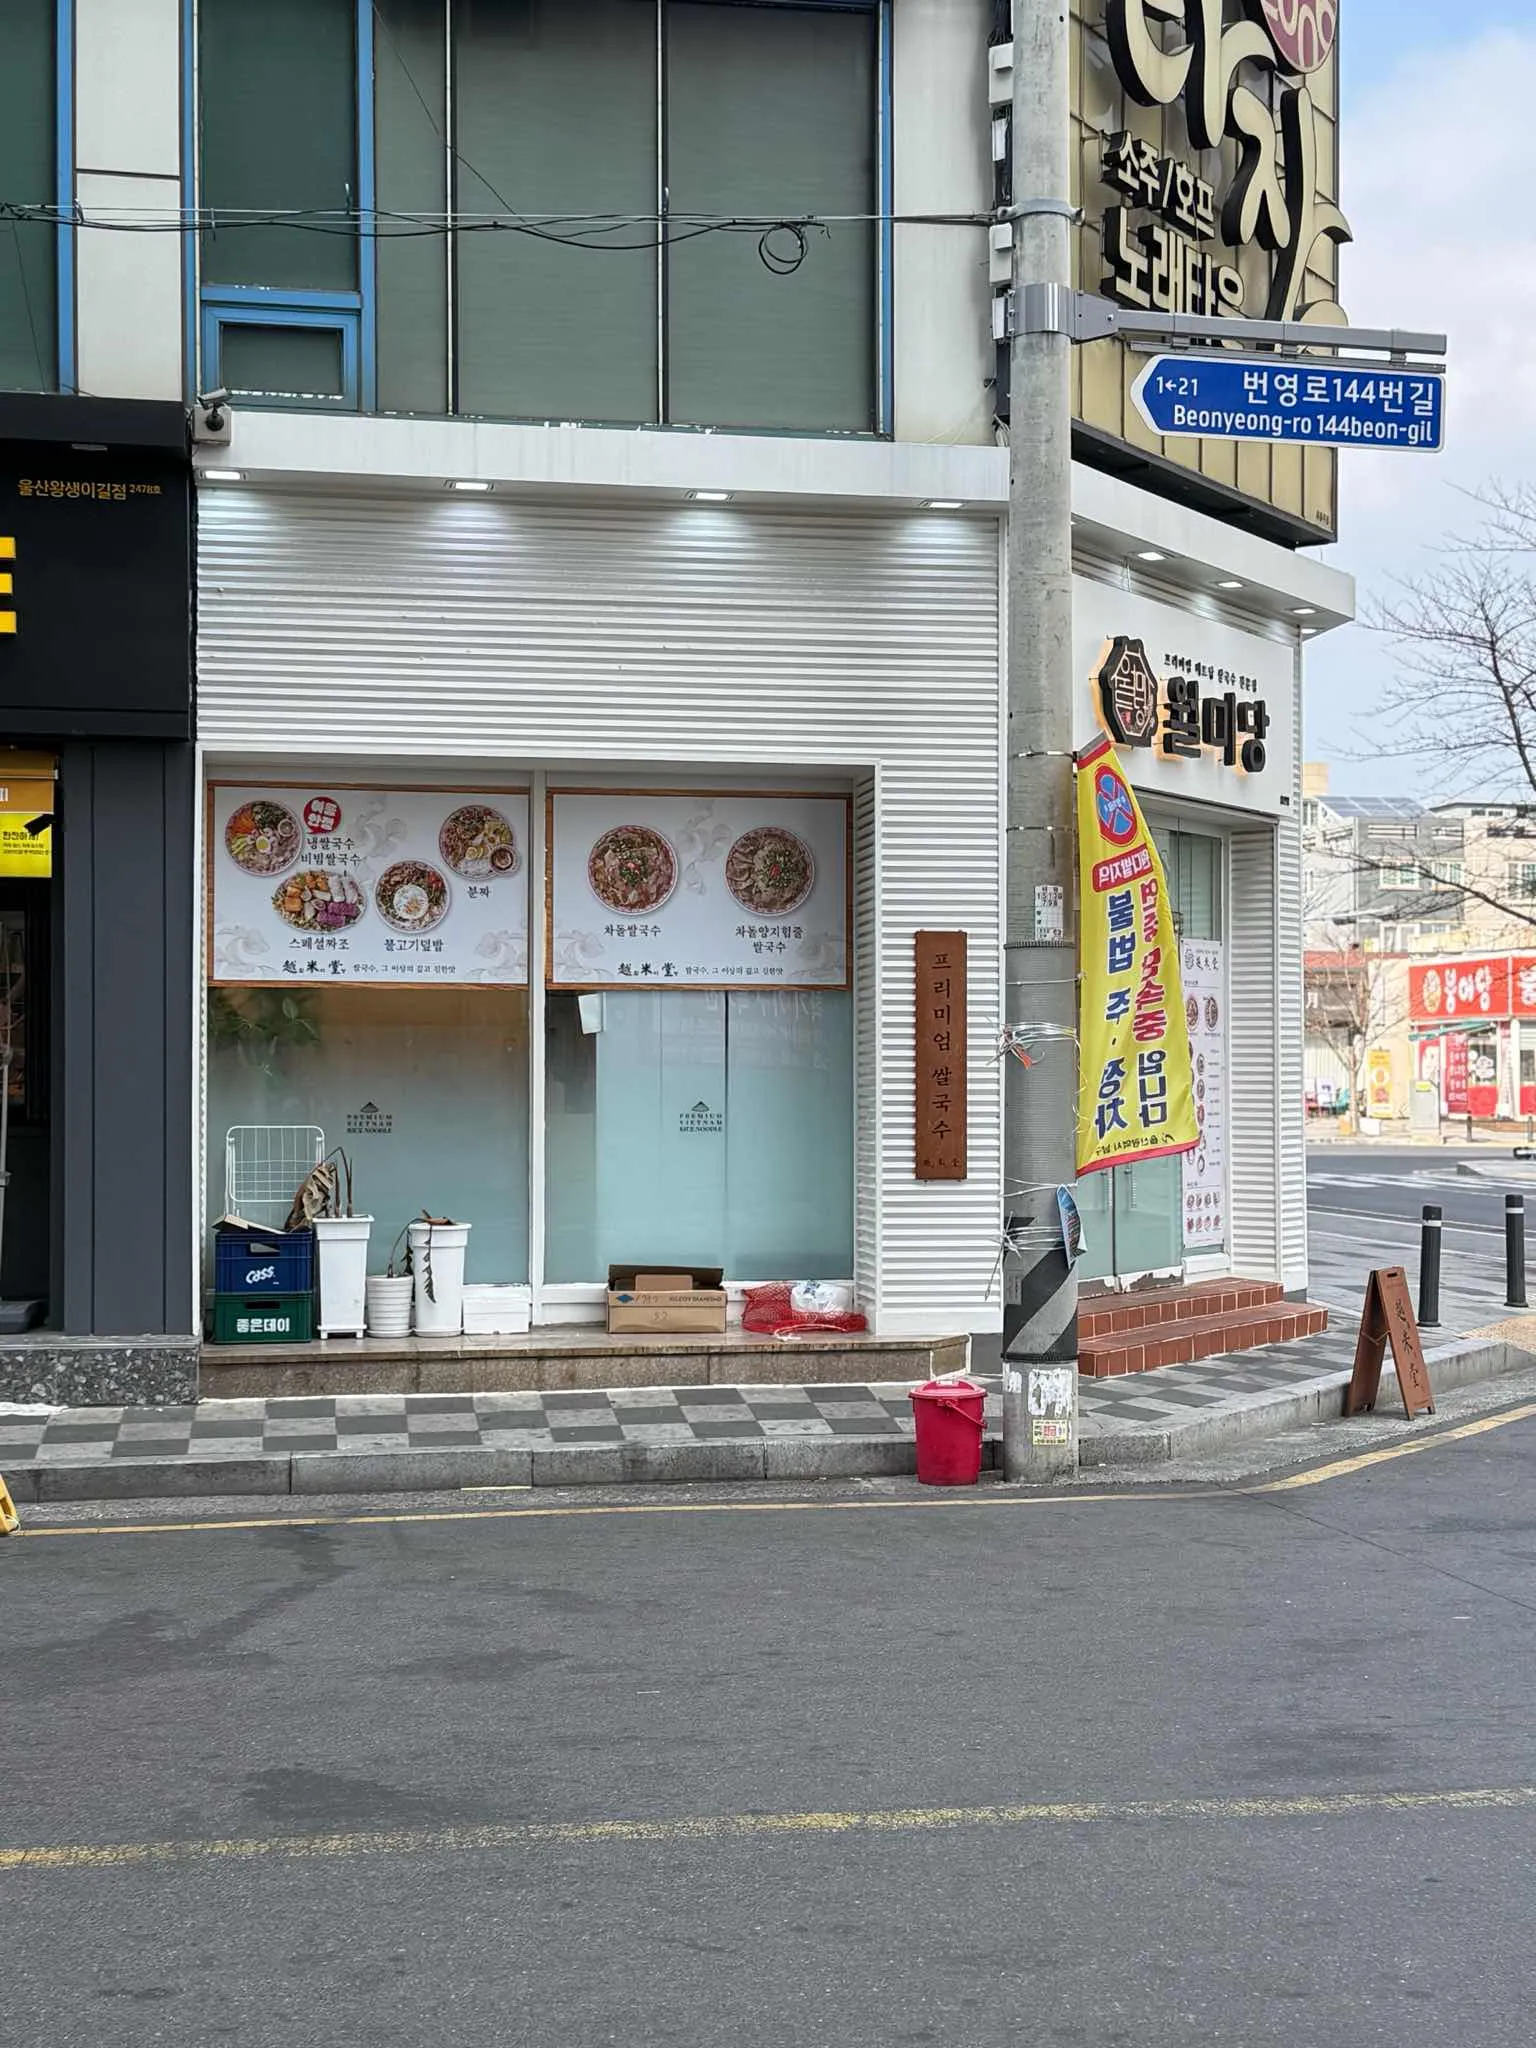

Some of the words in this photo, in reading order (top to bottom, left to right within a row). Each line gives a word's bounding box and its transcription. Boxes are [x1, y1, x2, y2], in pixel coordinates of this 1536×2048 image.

[1243, 371, 1434, 417] 번영로144번길
[1173, 404, 1312, 436] Beonyeong-ro
[1317, 412, 1434, 444] 144beon-gil
[1162, 676, 1271, 773] 월미당
[301, 852, 363, 867] 비빔쌀국수
[931, 952, 953, 1053] 프리미엄
[931, 1065, 953, 1141] 쌀국수
[236, 1316, 291, 1333] 좋은데이
